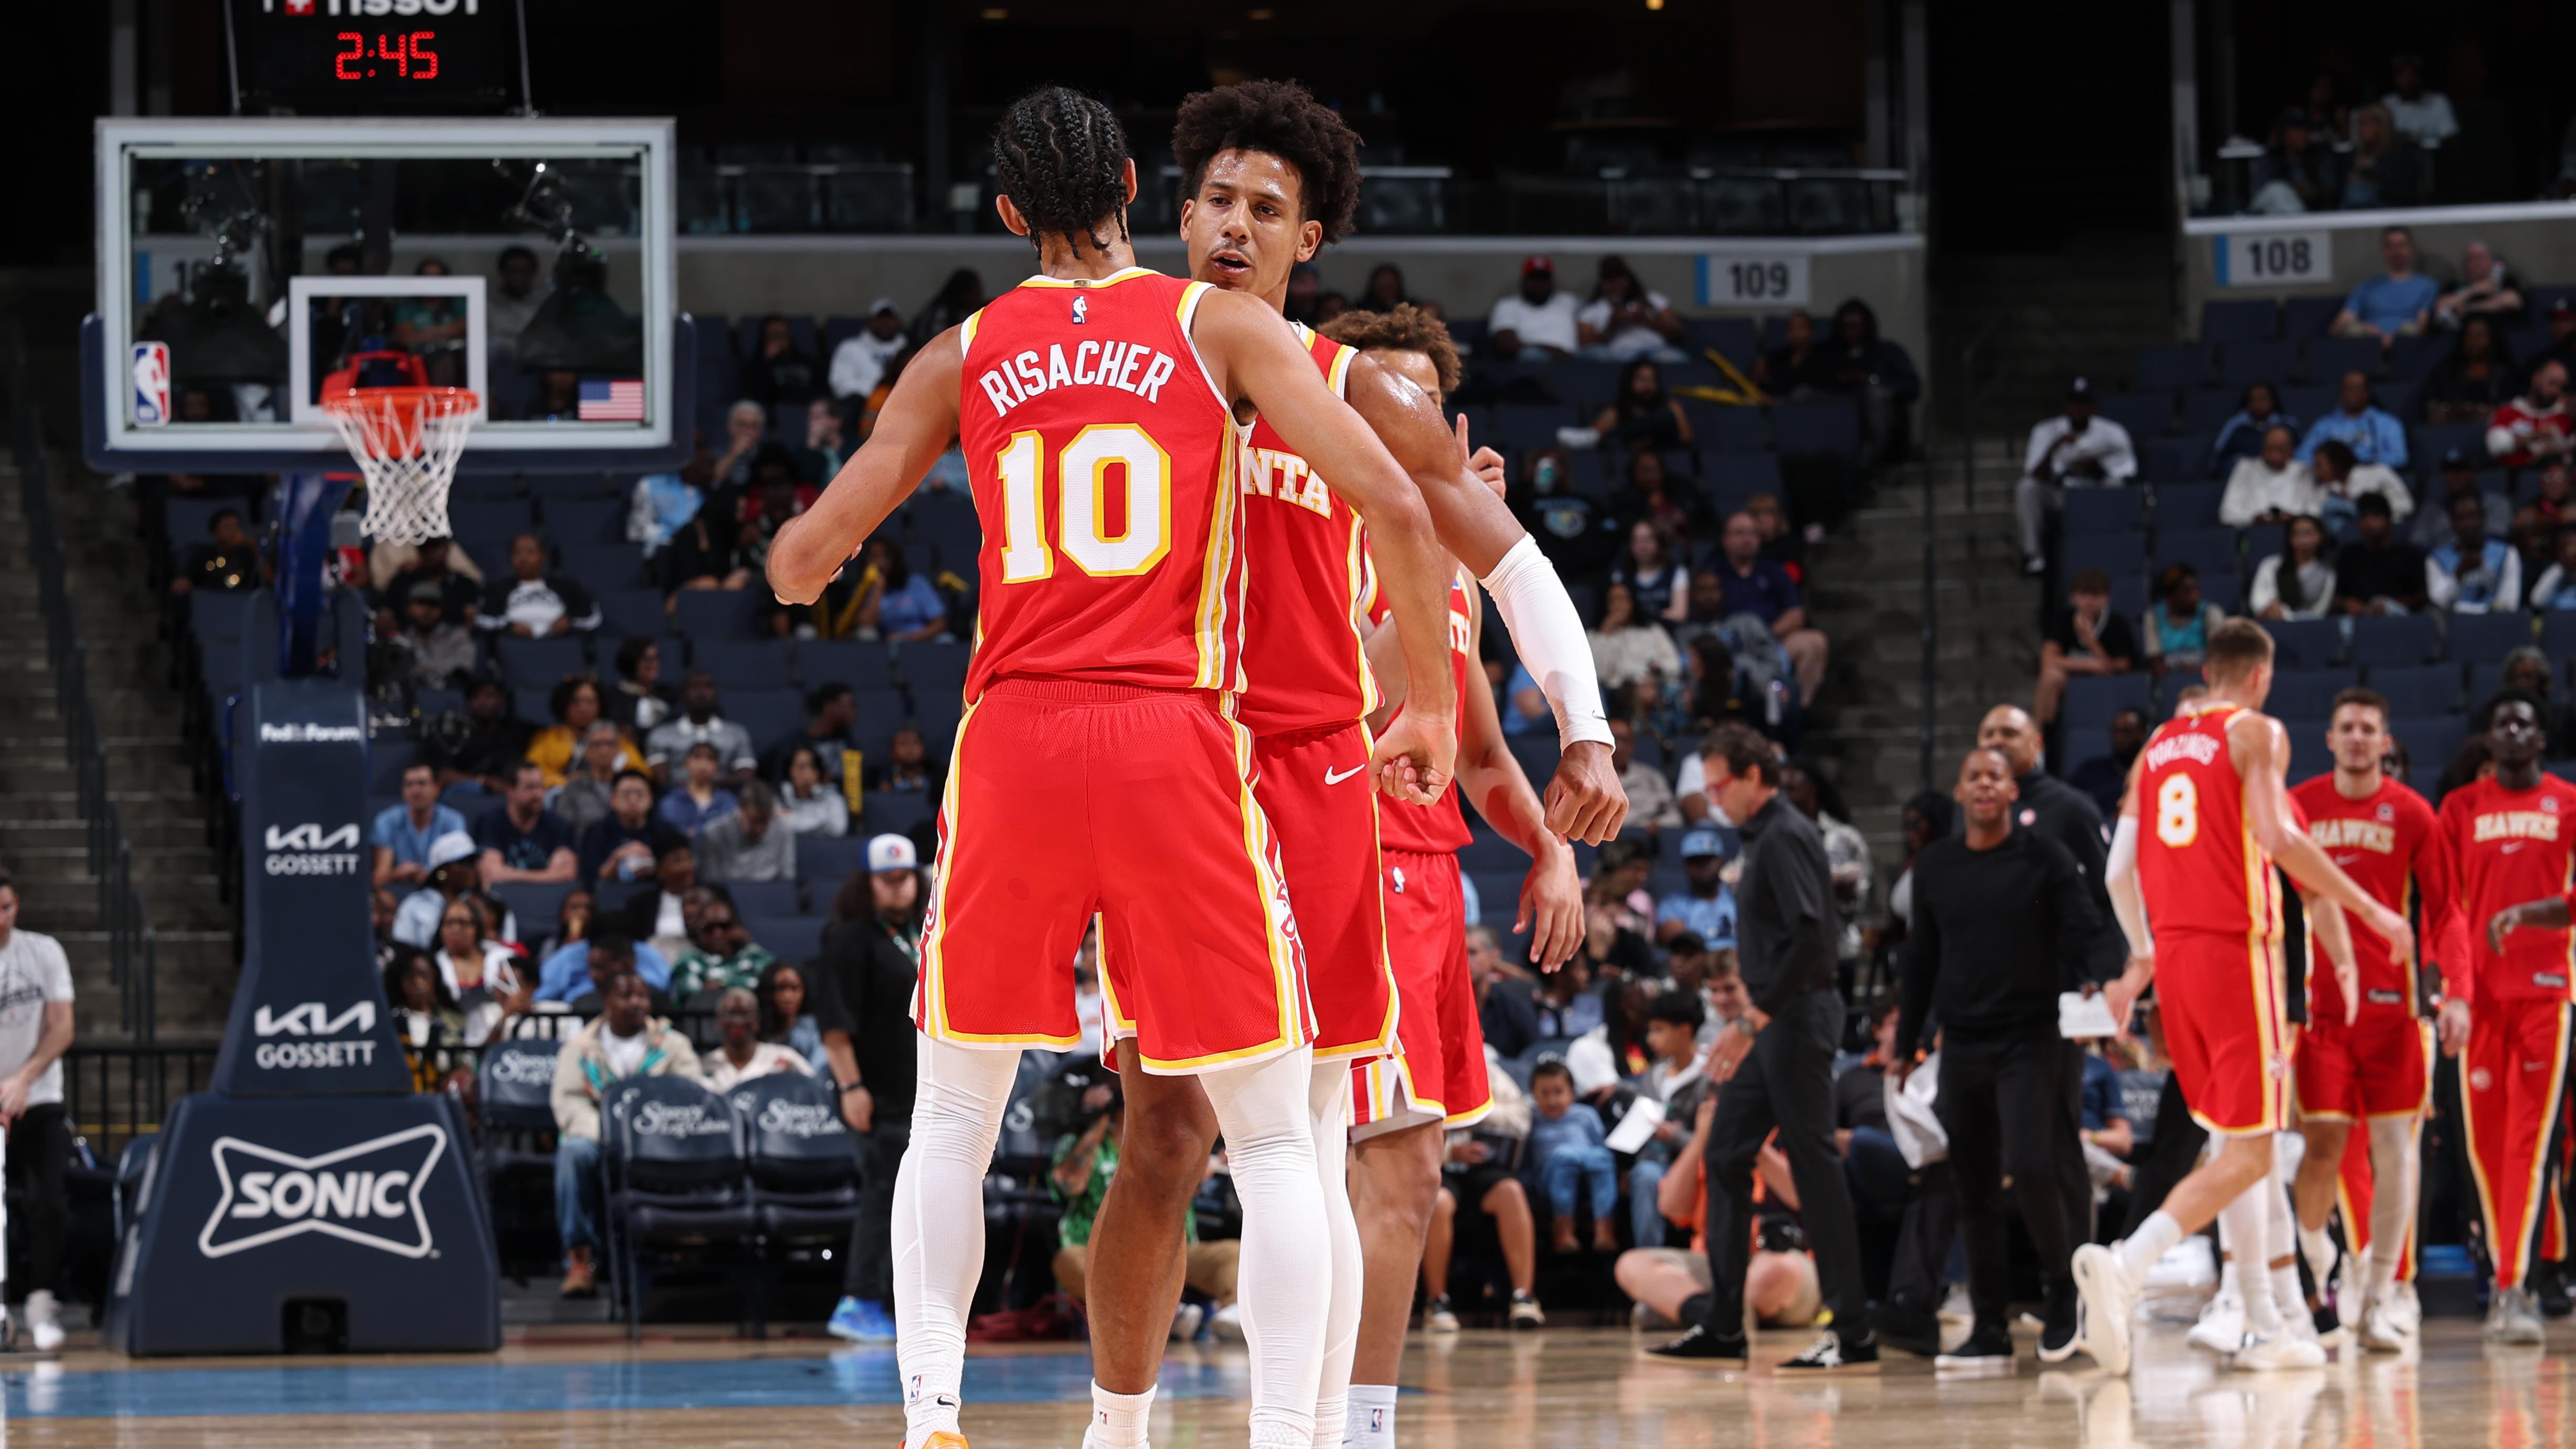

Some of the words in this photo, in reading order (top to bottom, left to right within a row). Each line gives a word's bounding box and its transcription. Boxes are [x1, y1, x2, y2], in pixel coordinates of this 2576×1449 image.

[336, 32, 438, 79] 2:45
[2249, 239, 2311, 275] 108
[1729, 262, 1789, 298] 109
[979, 340, 1175, 417] RISACHER
[997, 423, 1171, 584] 10
[2156, 771, 2198, 848] 8
[2474, 811, 2560, 843] HAWKS
[2310, 818, 2395, 854] HAWKS
[265, 853, 360, 875] GOSSETT
[256, 1040, 376, 1069] GOSSETT
[231, 1171, 410, 1218] SONIC
